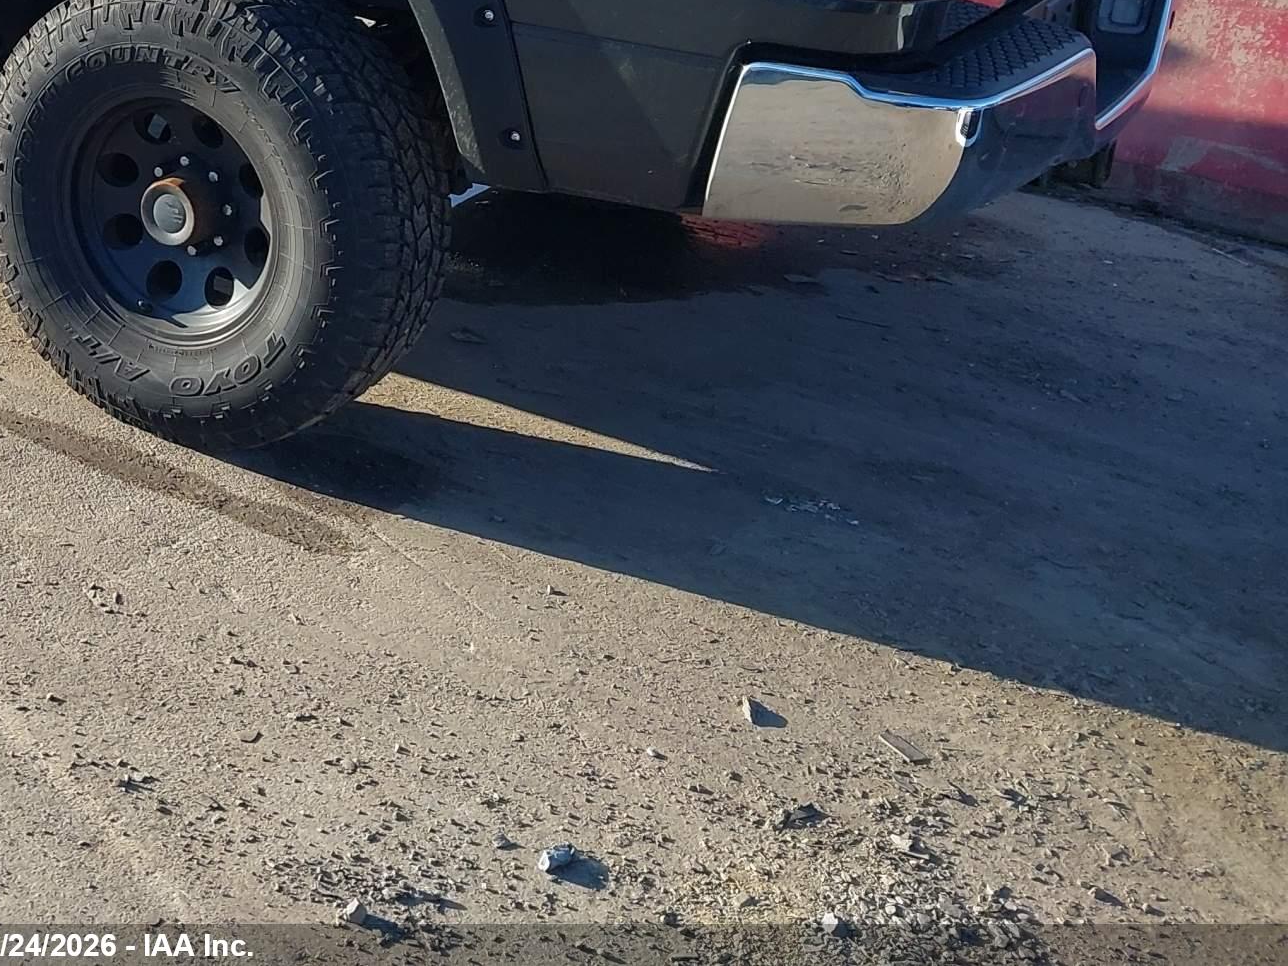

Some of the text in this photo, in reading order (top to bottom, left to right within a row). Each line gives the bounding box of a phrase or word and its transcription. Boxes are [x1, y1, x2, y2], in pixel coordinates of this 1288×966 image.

[64, 44, 241, 93] COUNTRY
[72, 333, 150, 381] A/T
[168, 332, 286, 396] TOYO
